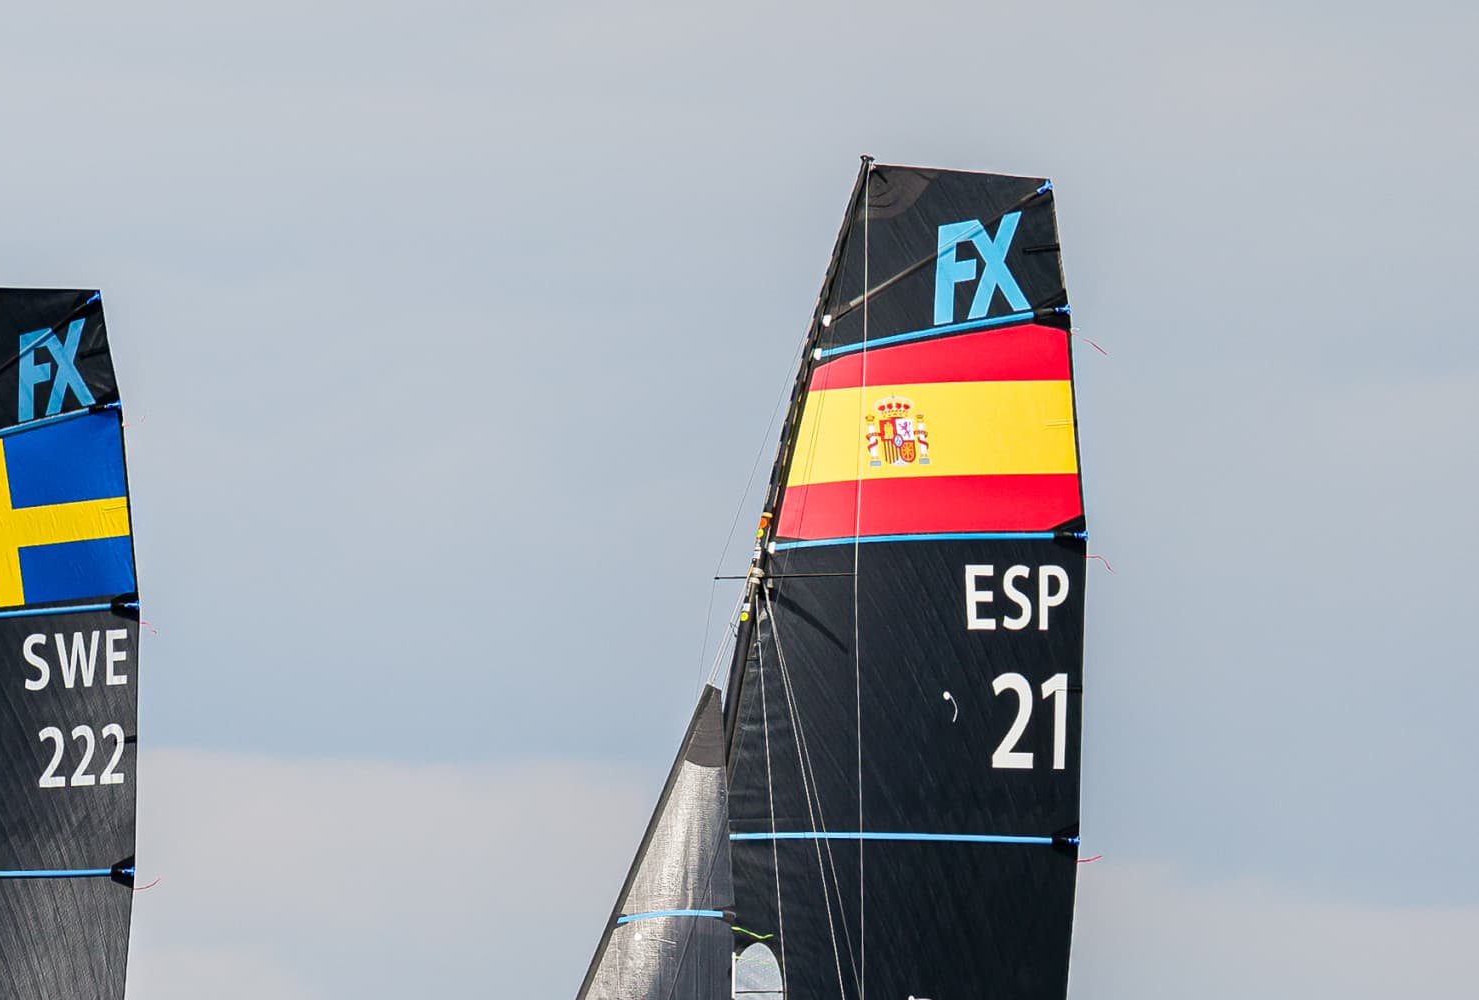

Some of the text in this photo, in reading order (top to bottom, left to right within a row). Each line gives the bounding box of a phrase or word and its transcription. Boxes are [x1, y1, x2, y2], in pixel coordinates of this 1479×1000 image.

[933, 210, 1034, 326] FX
[17, 317, 97, 423] FX
[964, 564, 1070, 631] ESP
[22, 628, 129, 692] SWE
[38, 723, 125, 788] 222
[991, 672, 1069, 770] 21
